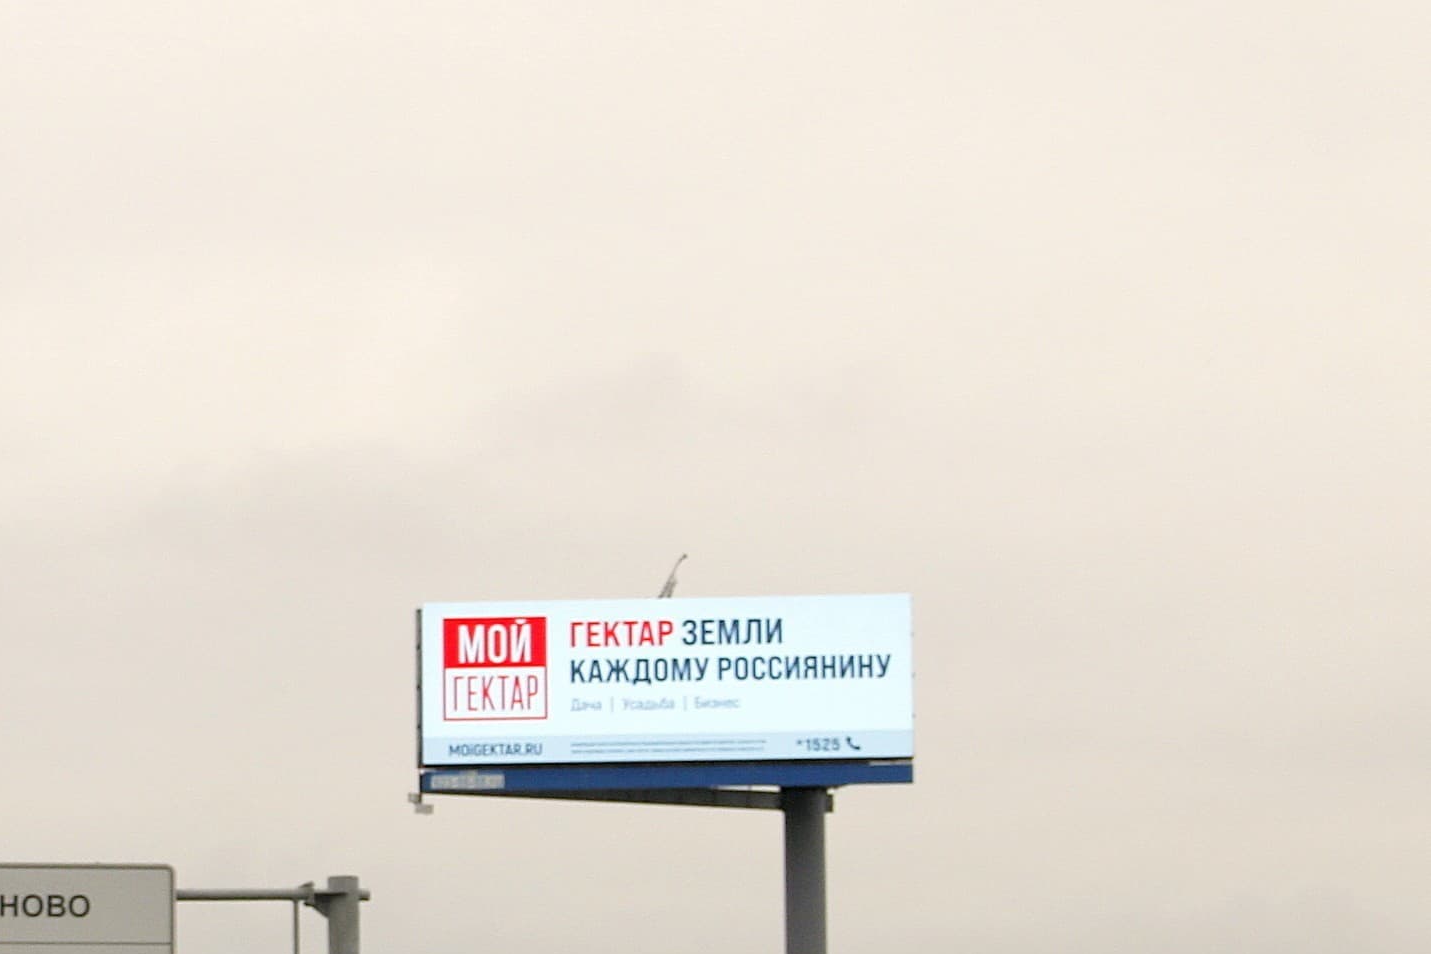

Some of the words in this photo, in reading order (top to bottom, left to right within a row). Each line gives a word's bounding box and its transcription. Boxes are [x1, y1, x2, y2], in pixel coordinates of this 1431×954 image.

[458, 618, 532, 664] МОЙ
[570, 620, 674, 648] ГЕКТАР
[681, 618, 783, 646] ЗЕМЛИ
[570, 657, 709, 685] КАЖДОМУ
[717, 653, 891, 681] РОССИЯНИНУ
[453, 675, 539, 712] ГЕКТАР
[570, 698, 603, 712] Дача
[694, 696, 741, 709] Бизнес
